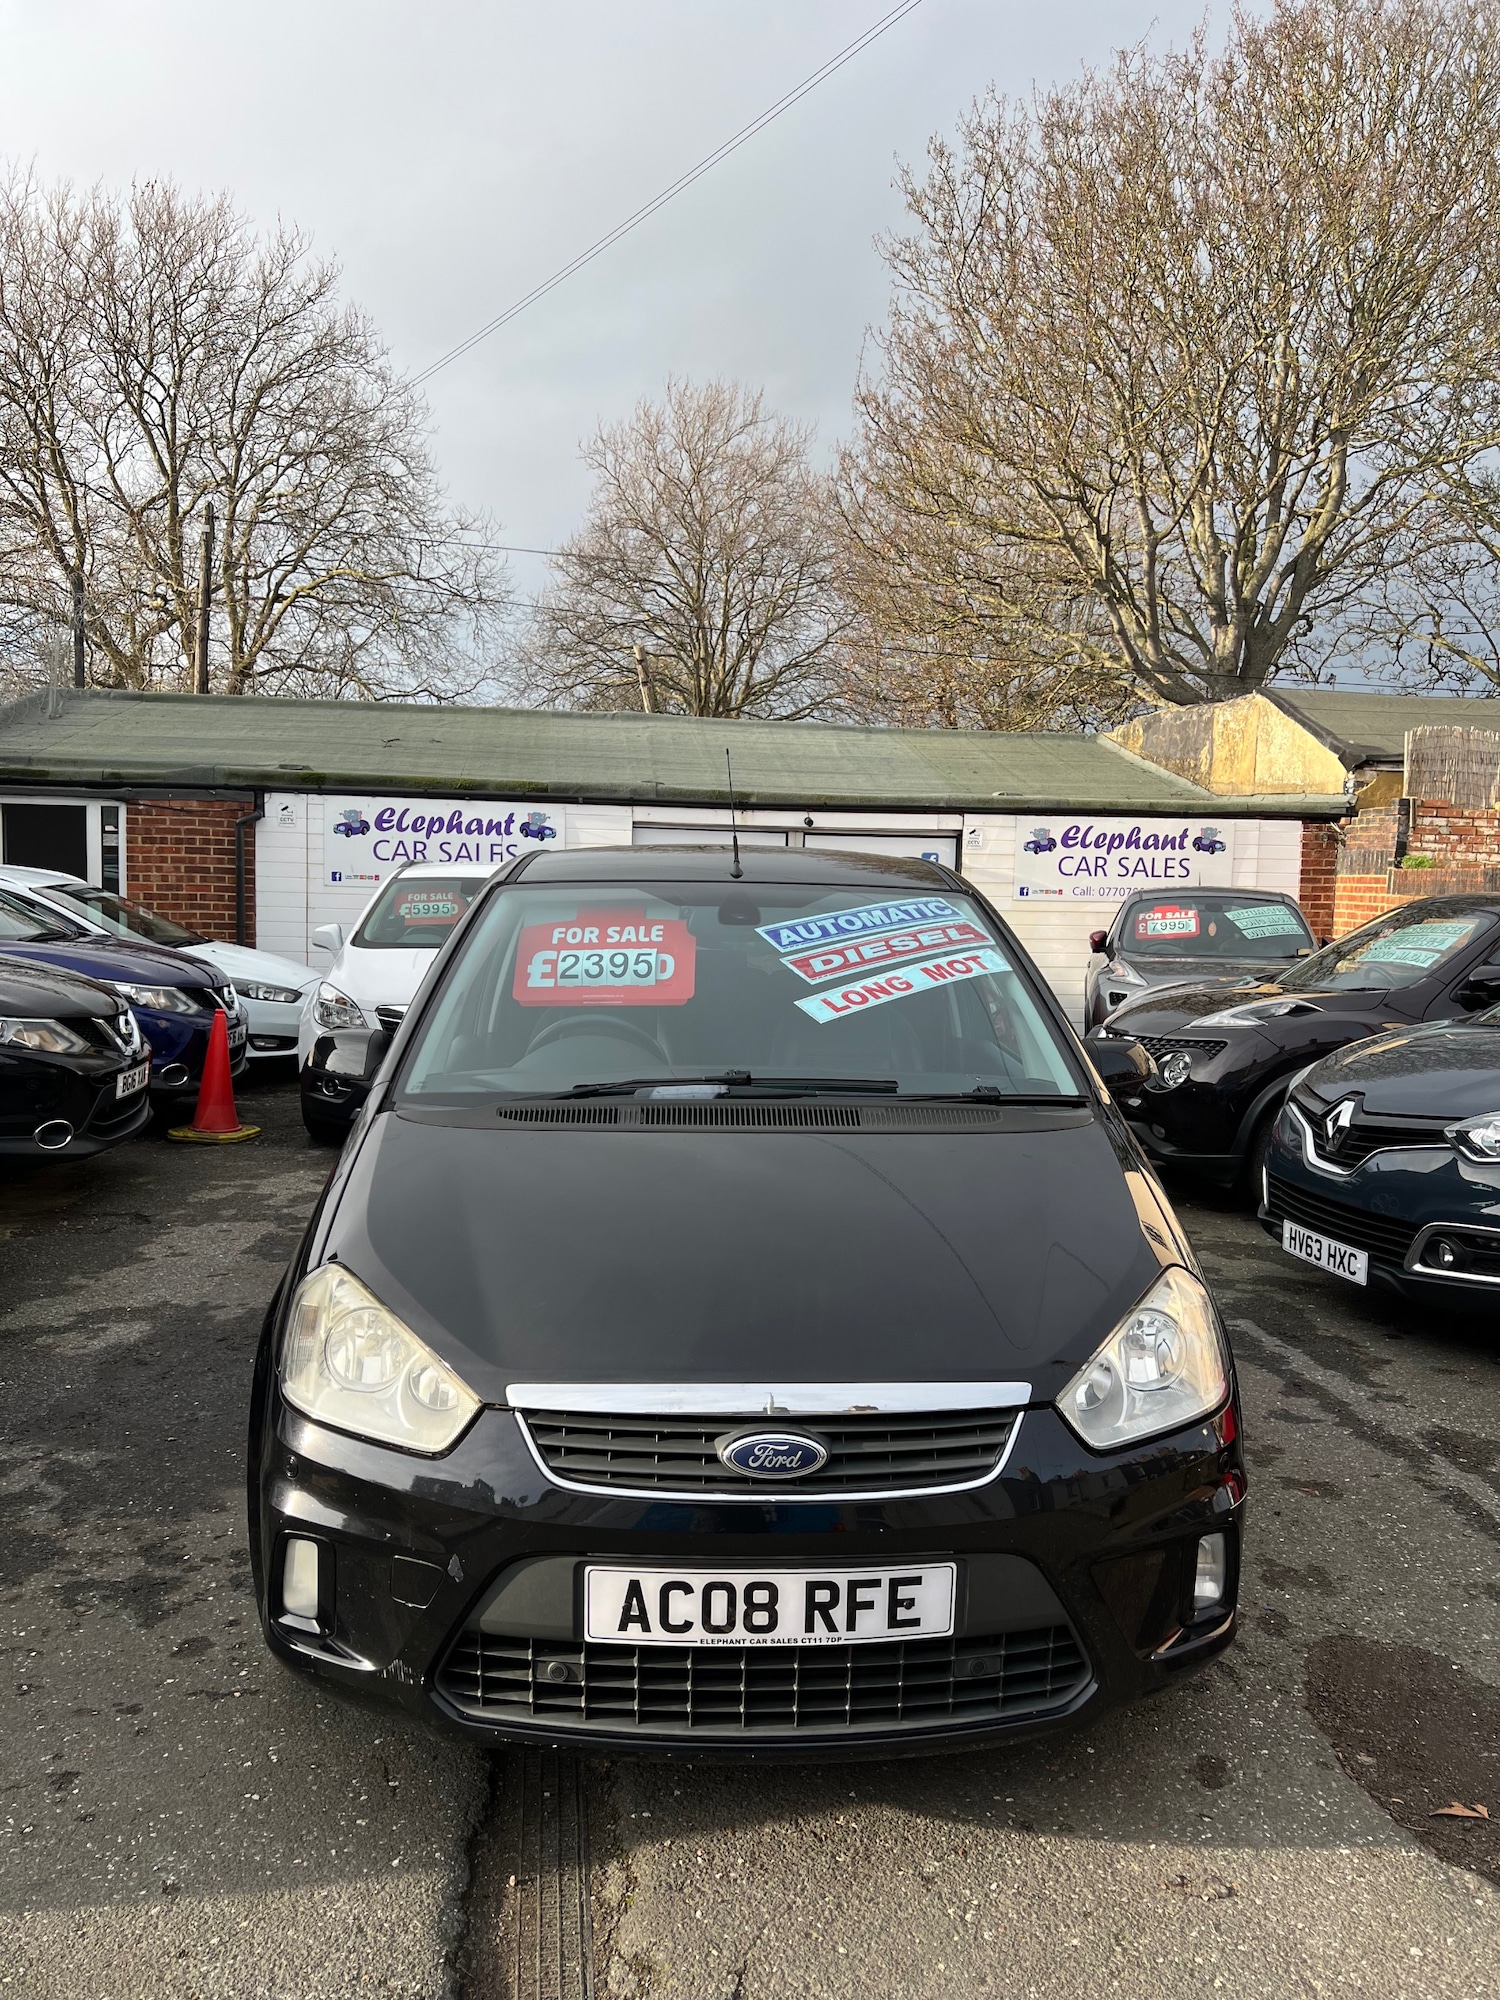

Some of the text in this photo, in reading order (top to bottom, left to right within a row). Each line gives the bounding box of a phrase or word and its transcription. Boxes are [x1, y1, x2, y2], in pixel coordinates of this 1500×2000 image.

[374, 807, 515, 839] Elephant
[373, 839, 428, 861] CAR
[1060, 825, 1188, 855] Elephant
[1058, 856, 1191, 878] CAR SALES
[407, 892, 454, 902] FOR SALE
[1072, 886, 1095, 896] Call:
[780, 901, 952, 946] AUTOMATIC
[1166, 911, 1195, 919] SALE
[552, 925, 665, 944] FOR SALE
[808, 928, 975, 973] DIESEL
[821, 955, 991, 1013] LONG MOT
[1289, 1227, 1357, 1276] HV63 HXC
[748, 1444, 803, 1468] Ford
[617, 1575, 923, 1634] AC08 RFE
[770, 1637, 798, 1645] SALES
